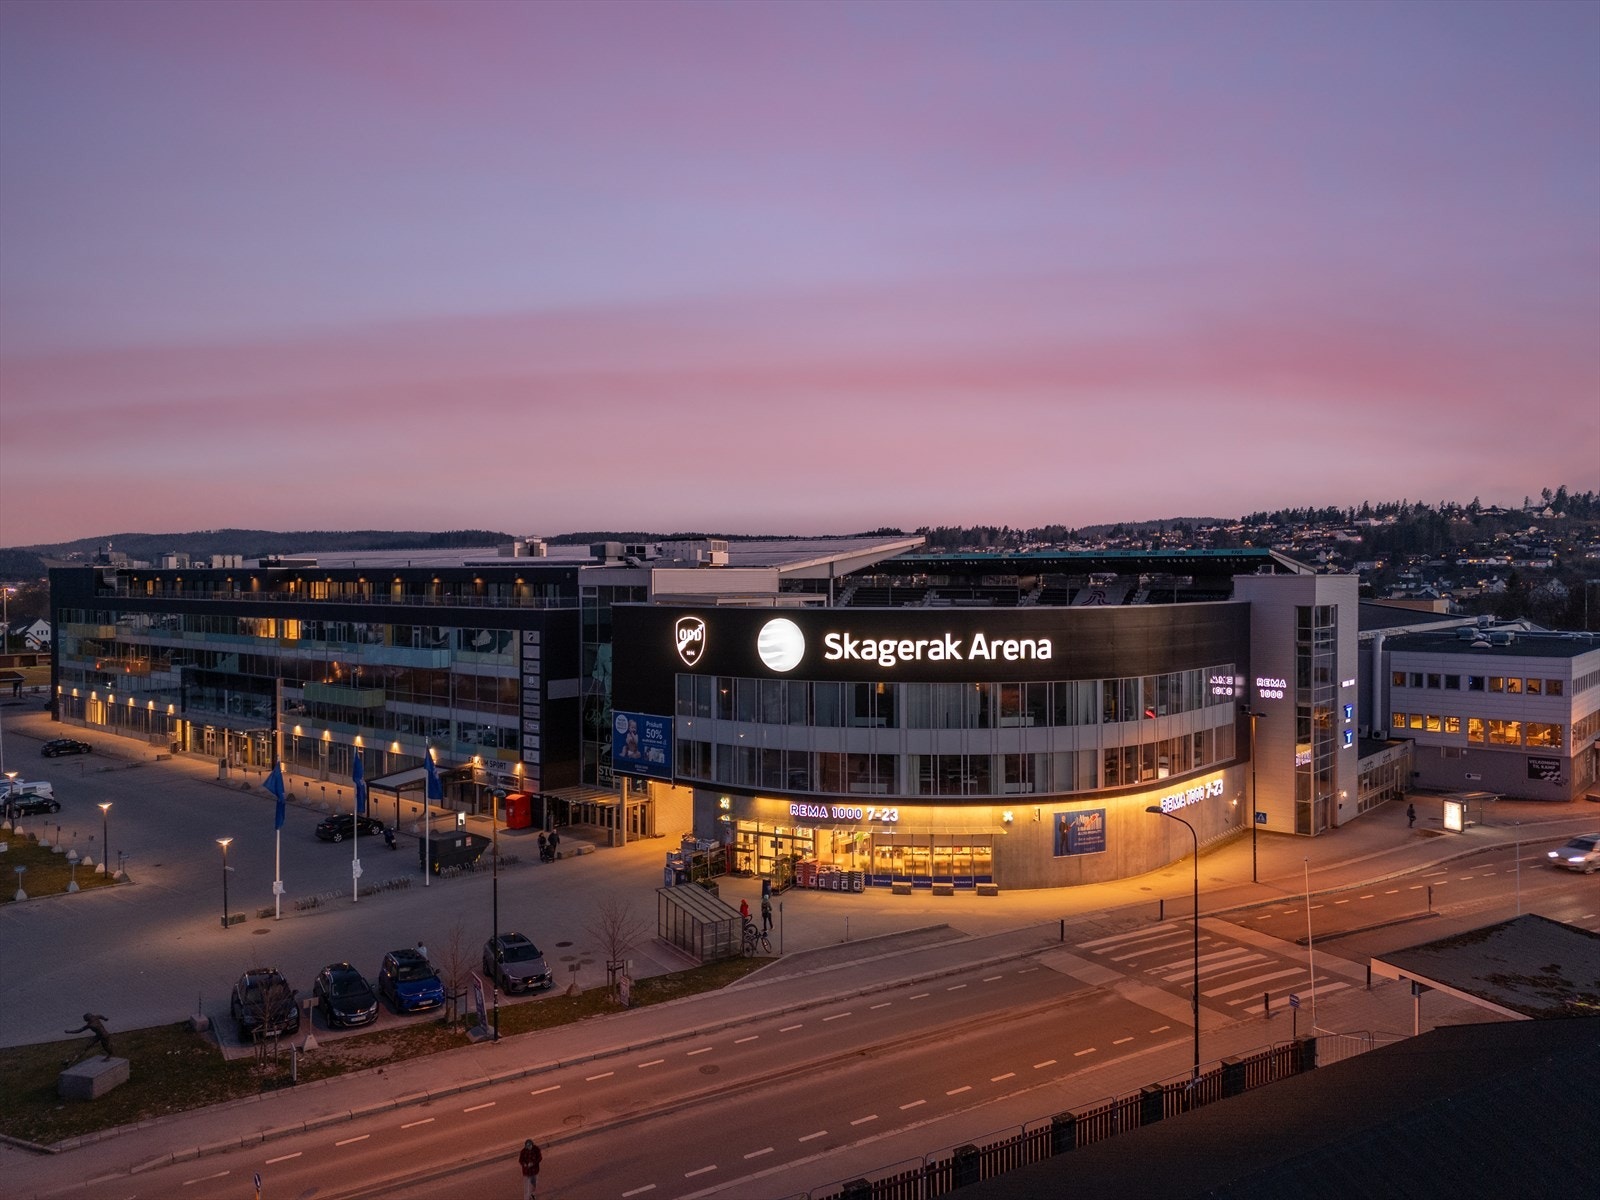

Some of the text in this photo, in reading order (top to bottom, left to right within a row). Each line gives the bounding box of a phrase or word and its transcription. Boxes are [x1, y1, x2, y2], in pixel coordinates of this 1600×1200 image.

[679, 628, 702, 641] ODD
[824, 632, 1052, 667] Skagerak Arena
[1256, 677, 1286, 688] REMA
[1259, 688, 1283, 699] 1000
[645, 728, 663, 740] 50%
[489, 760, 507, 770] SPORT
[1160, 778, 1224, 813] REMA 1000 7-23
[789, 803, 899, 822] REMA 1000 7-23
